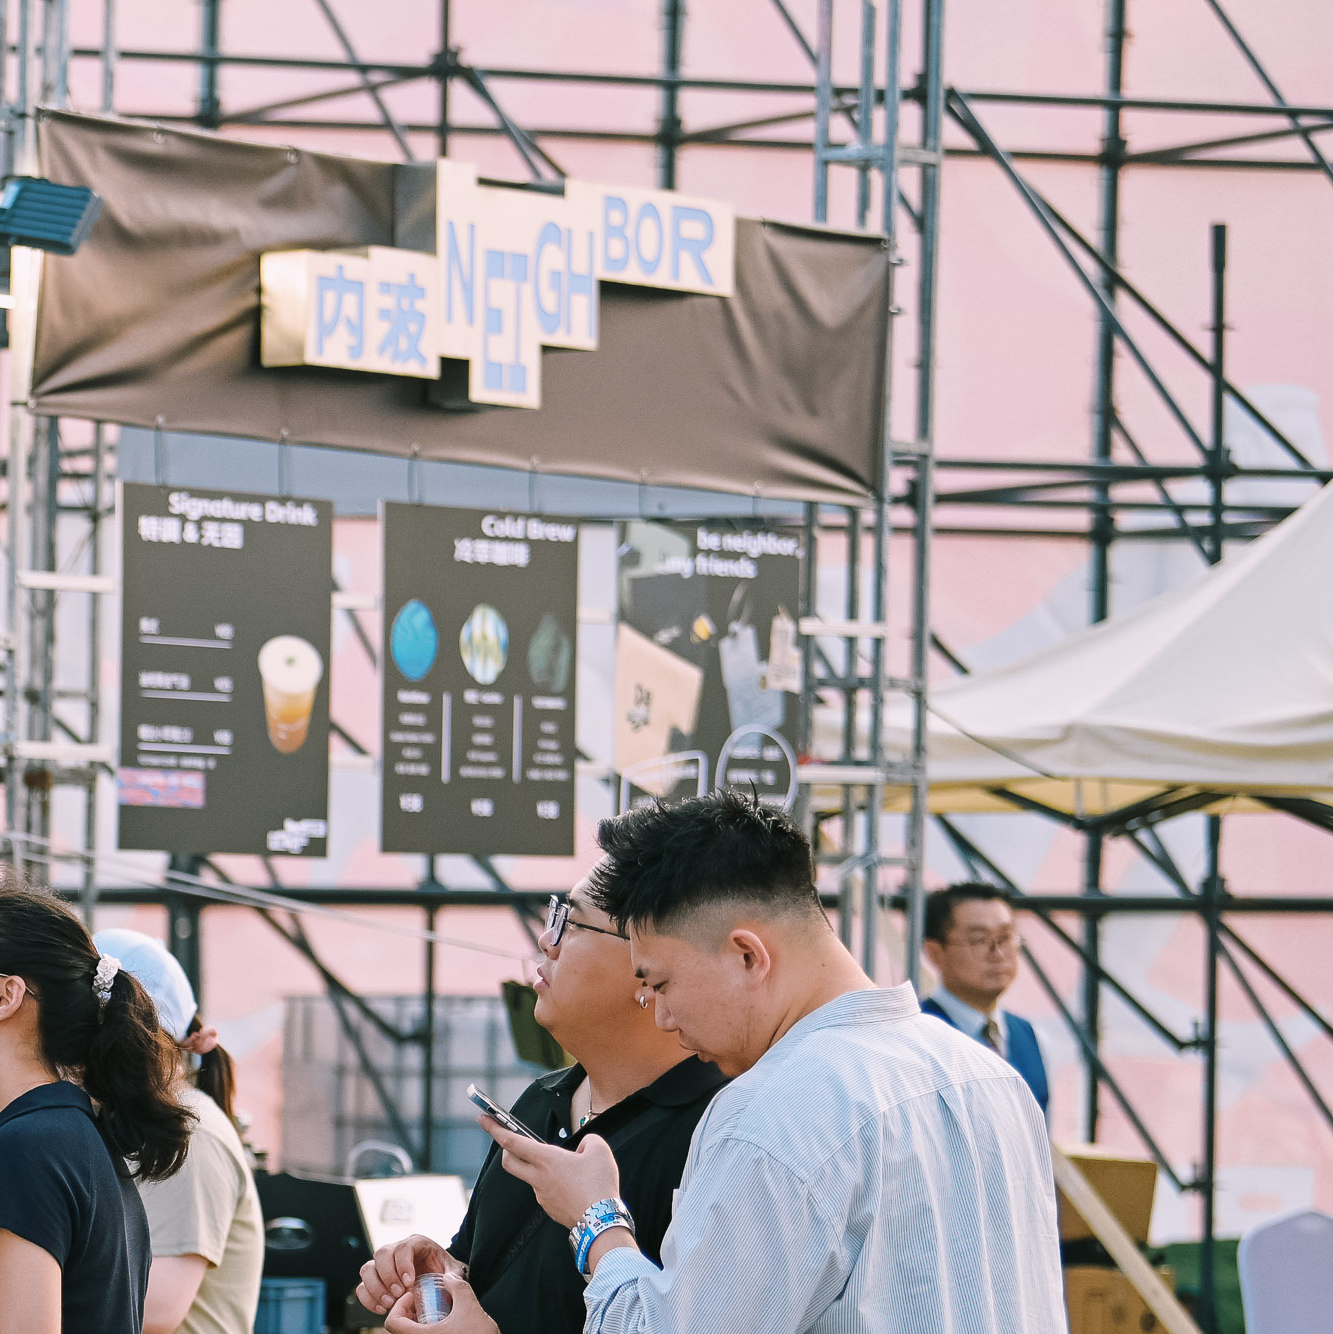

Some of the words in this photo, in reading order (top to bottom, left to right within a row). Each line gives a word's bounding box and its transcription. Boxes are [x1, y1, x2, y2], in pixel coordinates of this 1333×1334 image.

[316, 264, 429, 367] 内波
[169, 491, 264, 523] Signature
[265, 501, 319, 527] Drink
[481, 514, 526, 539] Cold
[527, 518, 577, 543] Brew
[696, 553, 758, 579] friends
